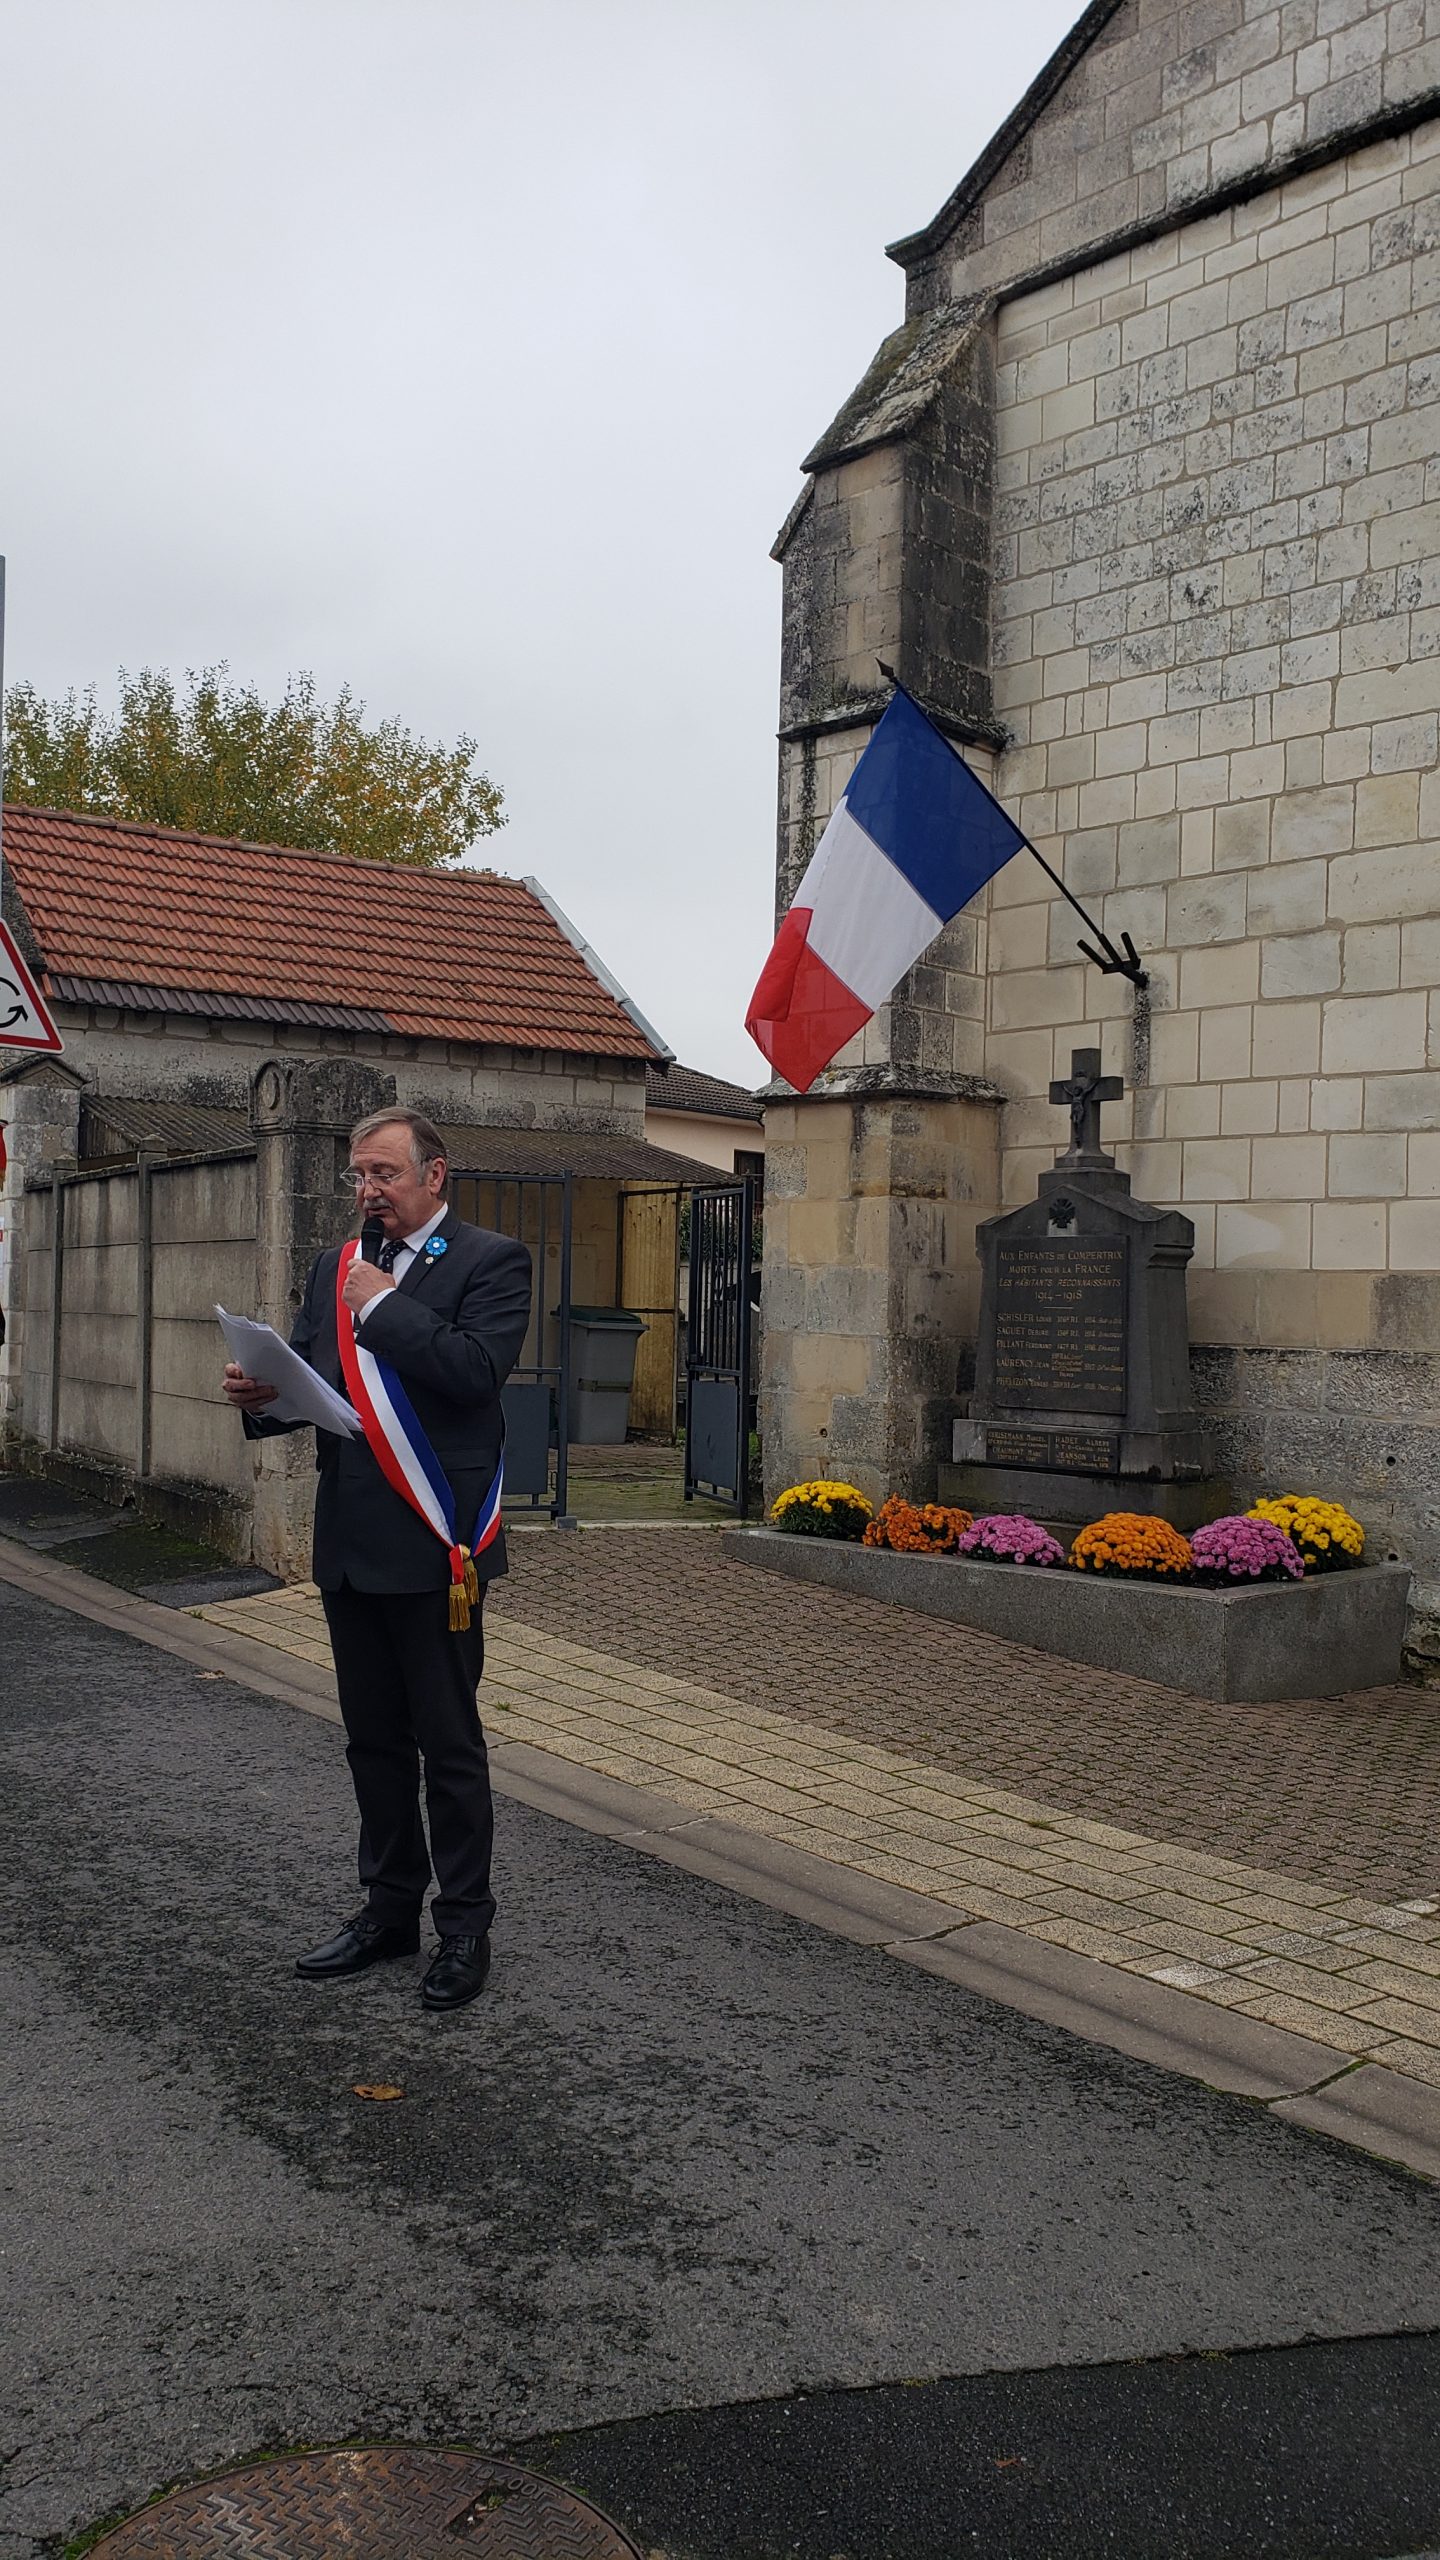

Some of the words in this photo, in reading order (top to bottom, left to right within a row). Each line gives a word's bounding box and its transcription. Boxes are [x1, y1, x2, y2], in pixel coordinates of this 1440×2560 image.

[999, 1251, 1014, 1261] AUX
[1018, 1250, 1055, 1261] ENFANTS
[1068, 1250, 1122, 1261] COMPERTRIX
[1009, 1264, 1036, 1274] MORTS
[1040, 1266, 1059, 1274] POUR
[1062, 1266, 1071, 1274] LA
[1075, 1263, 1111, 1274] FRANCE
[999, 1278, 1012, 1287] LES
[1015, 1278, 1053, 1287] HABITANTS
[1057, 1278, 1121, 1287] RECONNAISSANTS
